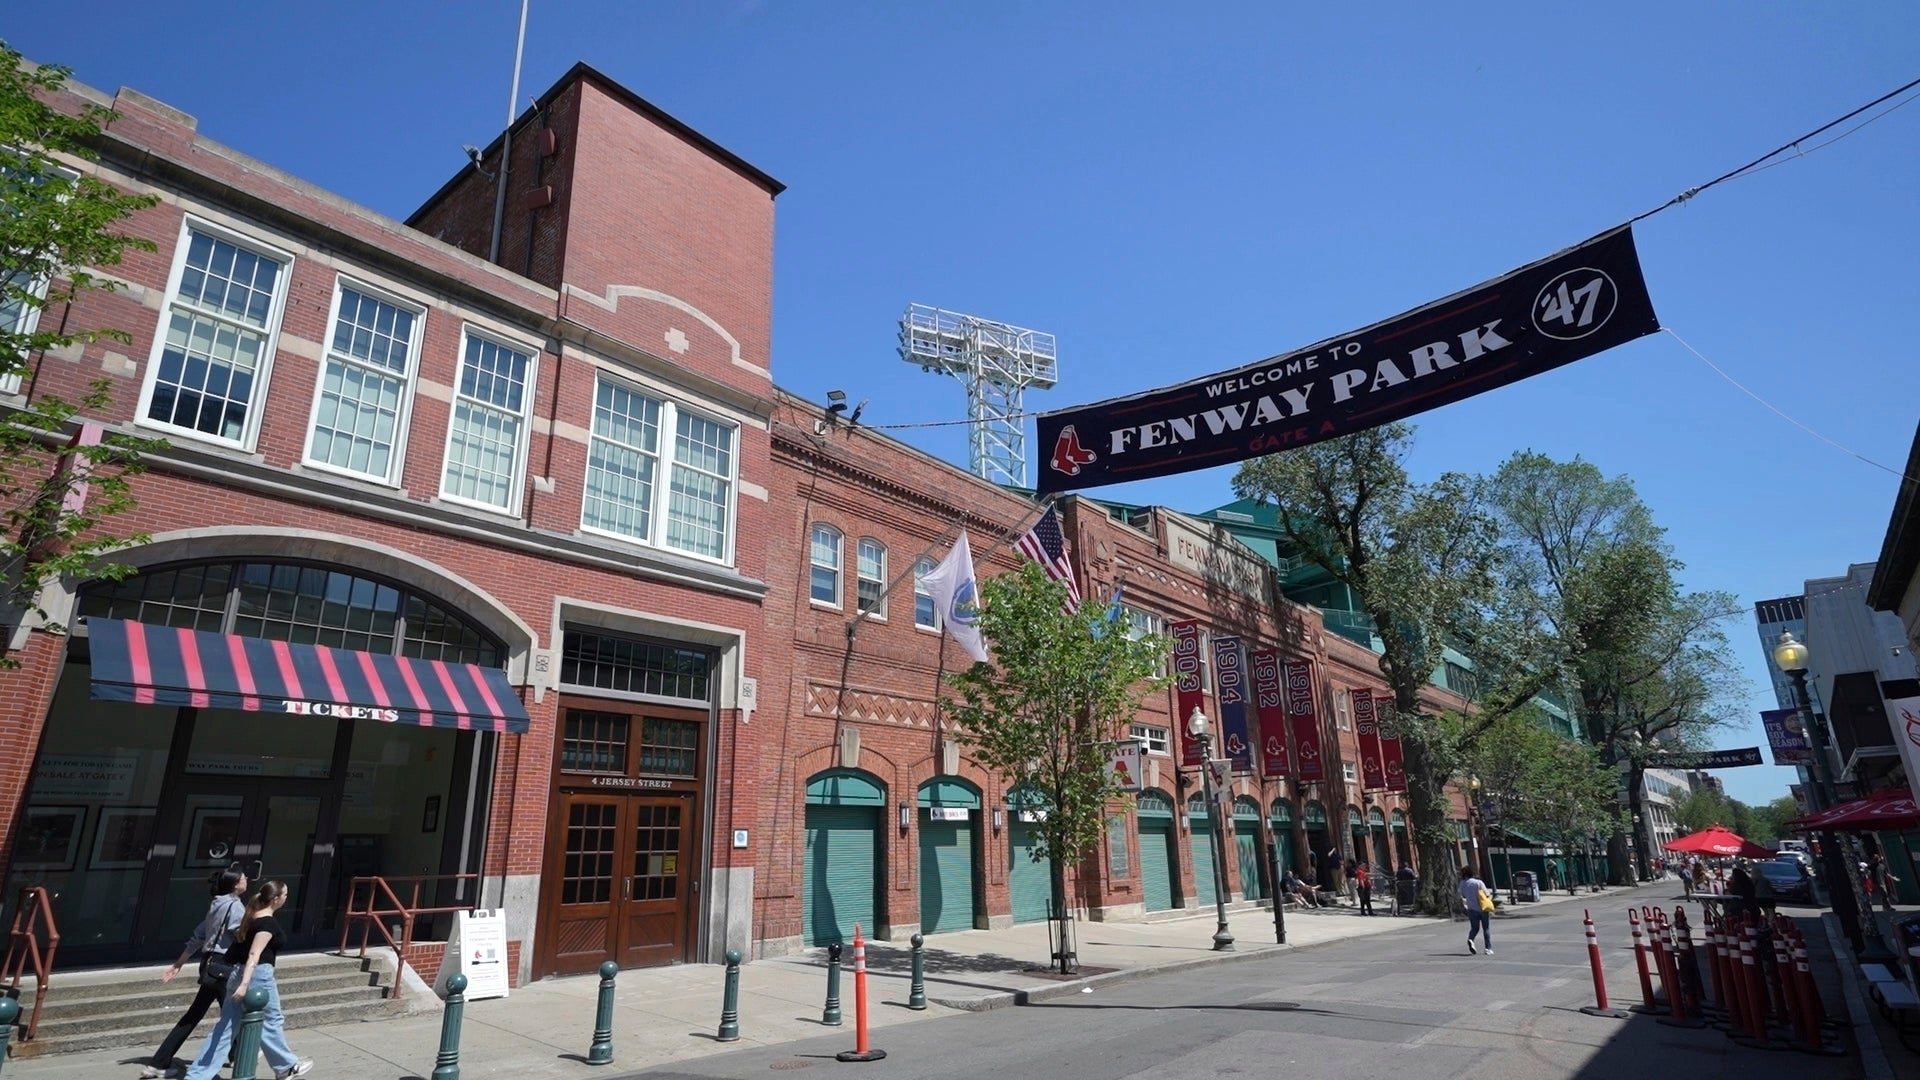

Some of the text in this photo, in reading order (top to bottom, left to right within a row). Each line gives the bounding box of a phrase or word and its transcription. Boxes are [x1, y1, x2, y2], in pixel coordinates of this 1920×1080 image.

[1205, 341, 1362, 398] WELCOME TO
[1109, 318, 1514, 455] FENWAY PARK
[1249, 420, 1335, 452] GATE A
[1173, 624, 1200, 693] 1903
[1215, 639, 1242, 704] 1904
[1254, 654, 1280, 708] 1912
[1287, 664, 1313, 717] 1915
[281, 700, 399, 722] TICKETS
[1353, 691, 1375, 736] 1916
[1765, 722, 1782, 731] IT'S
[1768, 730, 1786, 739] SOX
[1771, 737, 1804, 748] SEASON
[1110, 760, 1135, 785] A
[1705, 755, 1741, 764] PARK
[50, 771, 76, 779] SALE
[78, 771, 91, 779] AT
[92, 772, 118, 780] GATE
[591, 777, 673, 788] 4 JERSEY STREET
